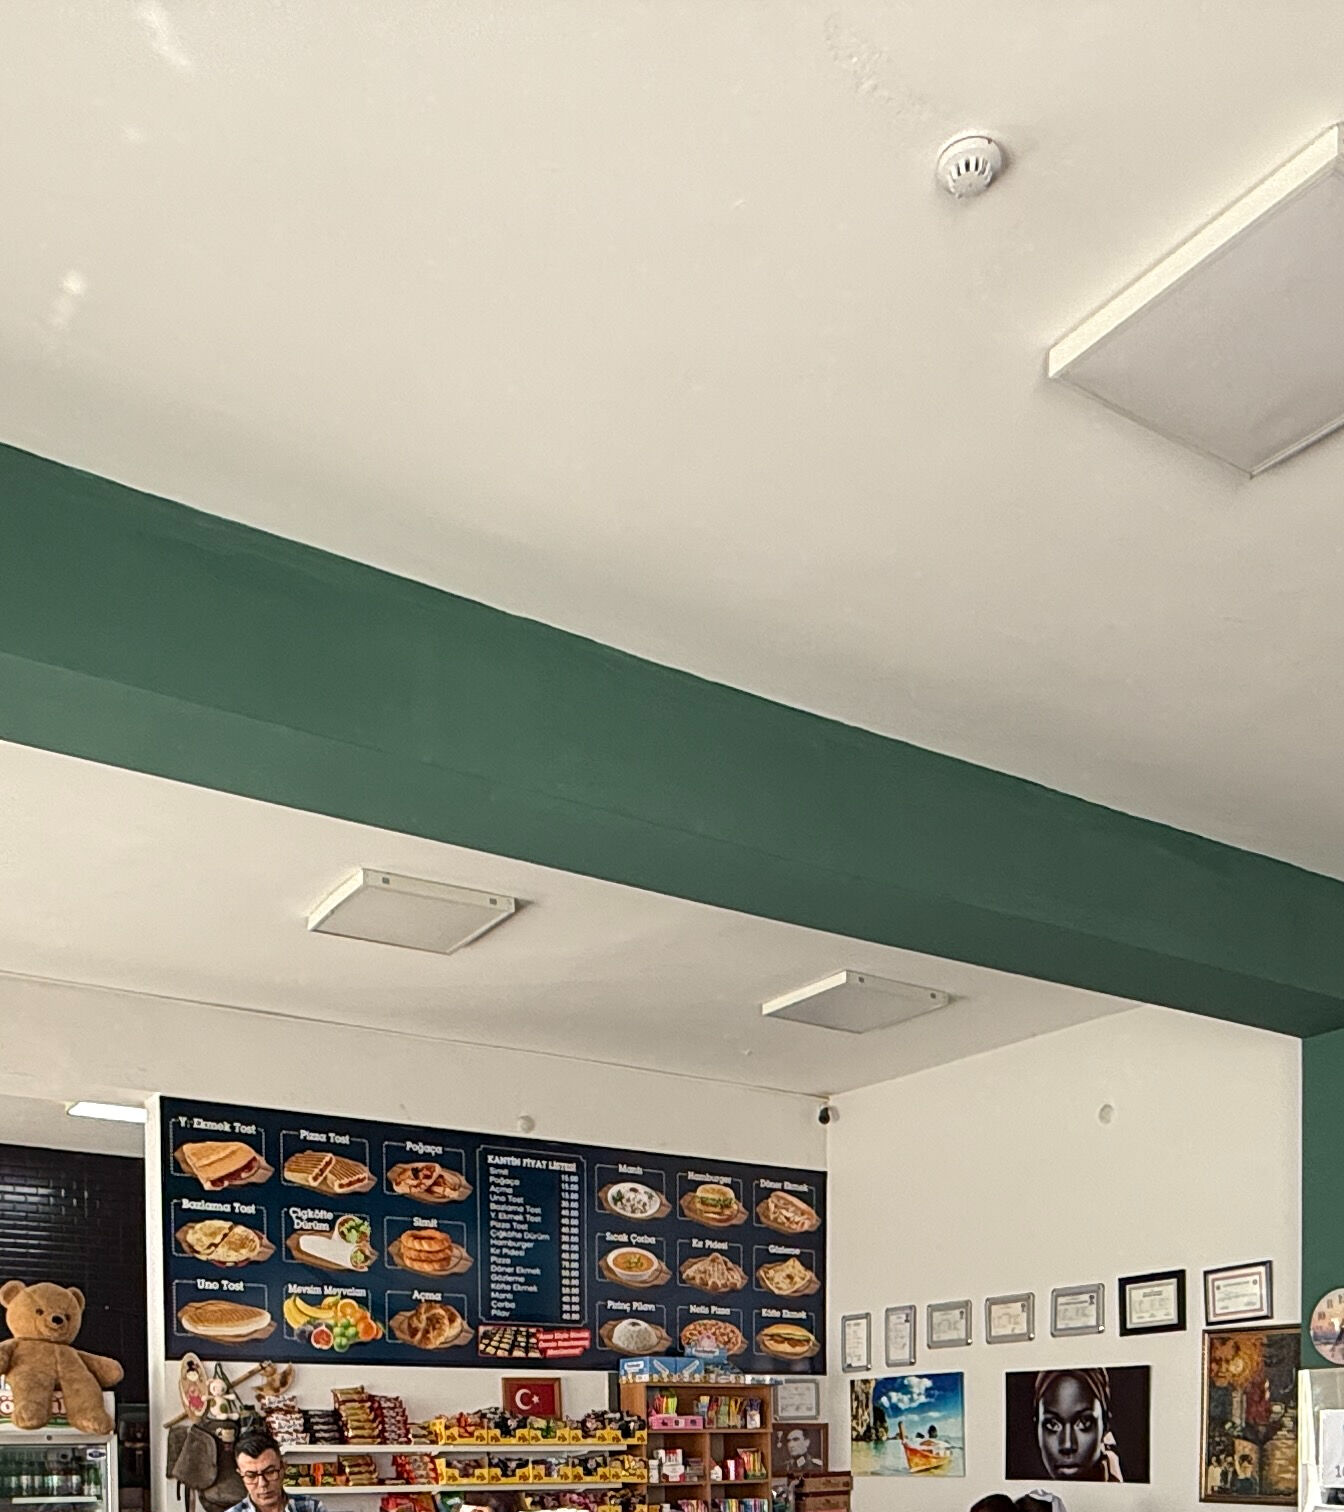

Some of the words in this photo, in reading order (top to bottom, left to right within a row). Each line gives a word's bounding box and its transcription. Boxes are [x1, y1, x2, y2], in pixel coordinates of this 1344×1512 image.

[193, 1118, 232, 1132] Ekmek
[233, 1122, 257, 1134] Tost
[299, 1130, 327, 1142] Pizza
[328, 1132, 350, 1144] Tost
[406, 1141, 443, 1155] Poğaça
[687, 1171, 732, 1185] Hamburger
[181, 1198, 232, 1212] Bazlama
[232, 1202, 256, 1214] Tost
[507, 1195, 524, 1204] Tost
[294, 1218, 330, 1231] Dürüm
[413, 1216, 438, 1228] Simit
[630, 1233, 656, 1245] Çorba
[196, 1279, 220, 1291] Uno
[221, 1280, 244, 1291] Tost
[288, 1283, 322, 1295] Mevsim
[412, 1289, 442, 1302] Açma
